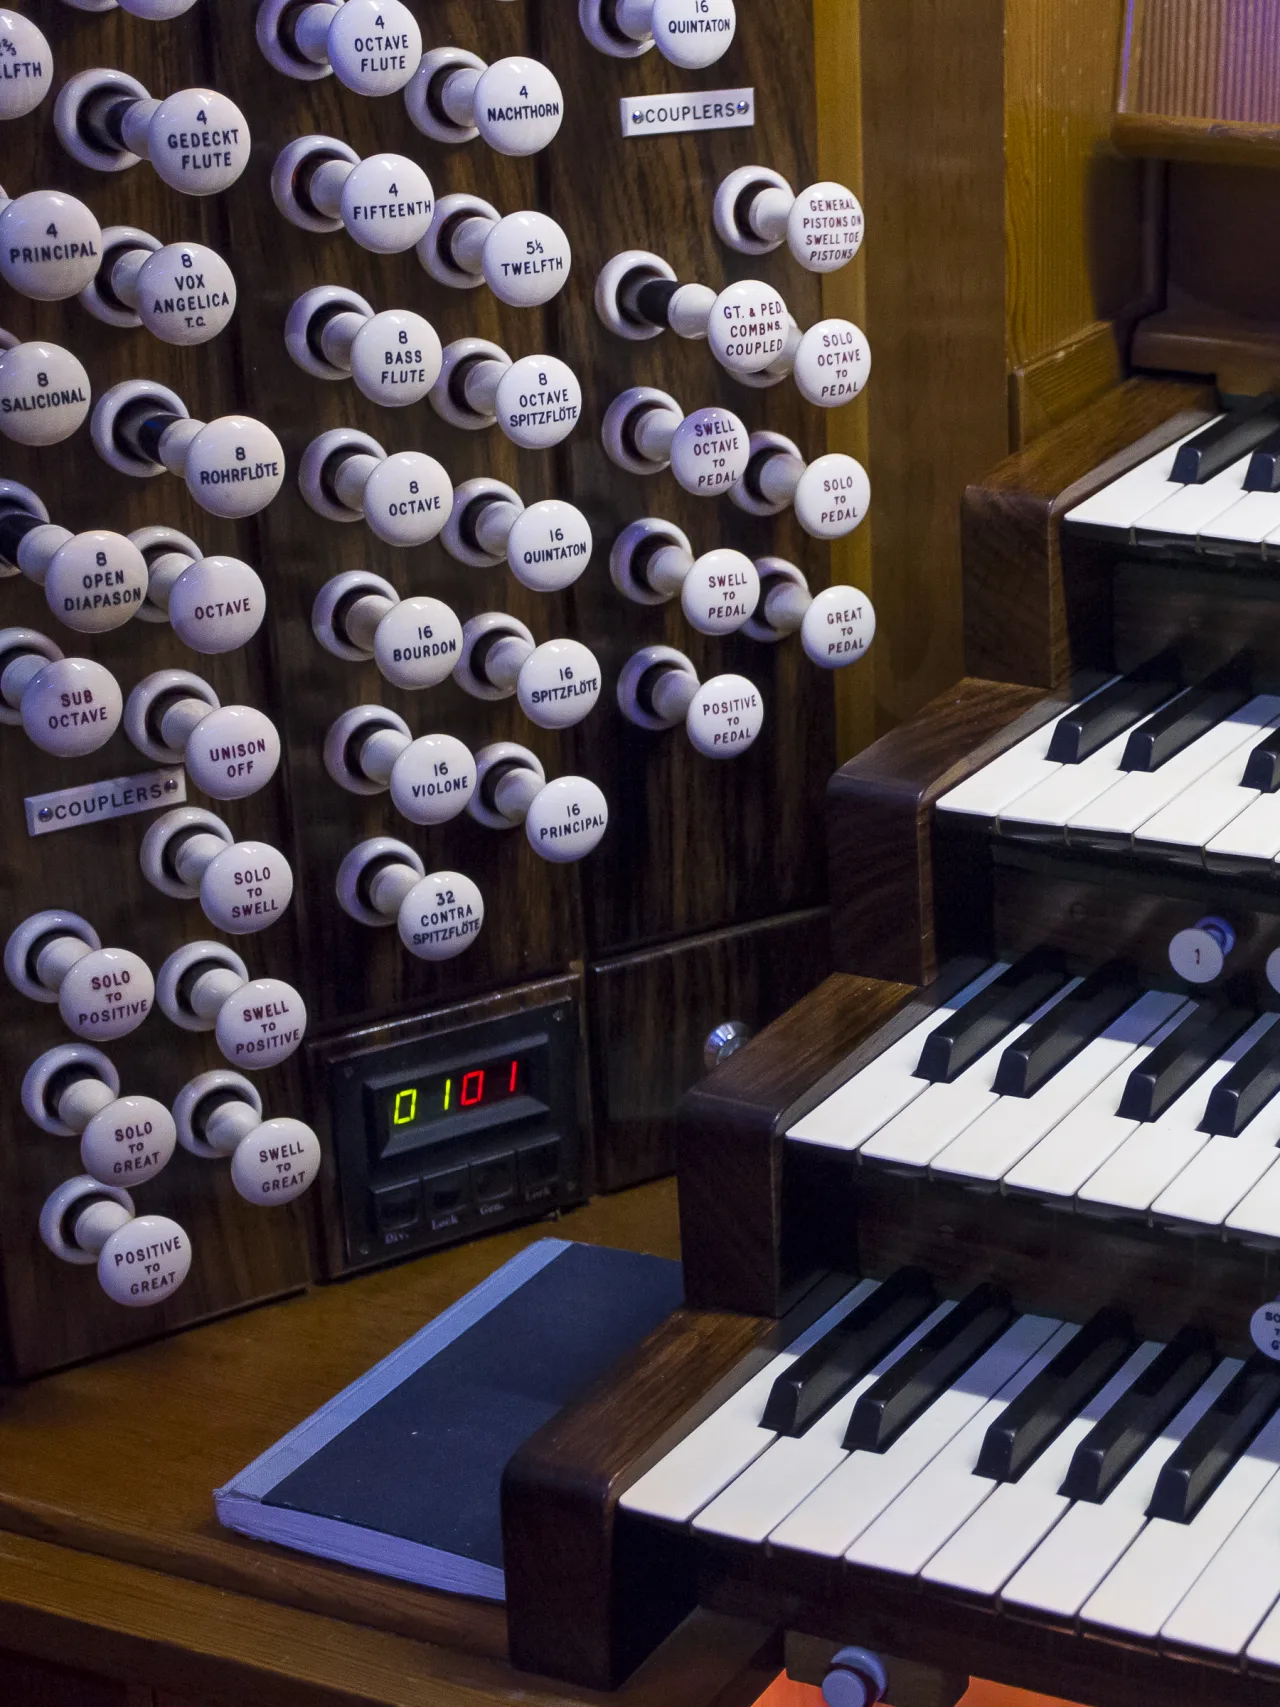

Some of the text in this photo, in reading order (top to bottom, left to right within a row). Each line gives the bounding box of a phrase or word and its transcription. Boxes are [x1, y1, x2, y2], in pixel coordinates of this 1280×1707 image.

[375, 15, 385, 29] 4
[668, 19, 730, 34] QUINTATON
[354, 35, 409, 53] OCTAVE
[361, 56, 406, 72] FLUTE
[519, 86, 528, 98] 4
[196, 110, 208, 124] 4
[487, 102, 559, 122] NACHTHORN
[645, 102, 735, 123] COUPLERS
[168, 129, 239, 149] GEDECKT
[182, 152, 232, 169] FLUTE
[388, 183, 398, 196] 4
[353, 201, 431, 220] FIFTEENTH
[809, 199, 855, 212] GENERAL
[46, 223, 58, 237] 4
[803, 216, 861, 229] PISTONS ON
[806, 232, 859, 245] SWELL TOE
[10, 242, 97, 263] PRINCIPAL
[181, 254, 192, 268] 8
[810, 249, 853, 261] PISTONS
[501, 257, 563, 276] TWELFTH
[174, 274, 205, 291] VOX
[153, 292, 230, 313] ANGELICA
[723, 301, 783, 319] GT. & PED.
[398, 331, 408, 344] 8
[822, 332, 853, 348] SOLO
[726, 338, 783, 357] COUPLED
[385, 350, 422, 365] BASS
[817, 349, 861, 366] OCTAVE
[37, 372, 49, 387] 8
[381, 369, 425, 384] FLUTE
[538, 373, 548, 385] 8
[836, 369, 848, 378] TO
[519, 389, 569, 407] OCTAVE
[821, 383, 859, 397] PEDAL
[1, 388, 86, 413] SALICIONAL
[509, 406, 578, 427] SPITZFLÖTE
[694, 420, 735, 437] SWELL
[235, 447, 246, 461] 8
[693, 438, 739, 456] OCTAVE
[713, 458, 725, 468] TO
[200, 463, 279, 485] ROHRFLÖTE
[698, 471, 737, 488] PEDAL
[409, 481, 419, 494] 8
[823, 477, 853, 492] SOLO
[389, 496, 441, 516] OCTAVE
[834, 495, 846, 505] TO
[821, 508, 858, 523] PEDAL
[550, 528, 564, 542] 16
[96, 552, 107, 566] 8
[523, 542, 587, 565] QUINTATON
[83, 570, 124, 589] OPEN
[708, 573, 748, 589] SWELL
[64, 587, 141, 611] DIAPASON
[723, 591, 736, 601] TO
[194, 598, 251, 620] OCTAVE
[708, 604, 747, 619] PEDAL
[827, 607, 863, 625] GREAT
[417, 626, 433, 640] 16
[841, 626, 854, 636] TO
[393, 639, 456, 662] BOURDON
[828, 638, 864, 655] PEDAL
[559, 666, 574, 680] 16
[61, 690, 93, 707] SUB
[531, 678, 598, 703] SPITZFLÖTE
[703, 695, 757, 716] POSITIVE
[48, 707, 108, 729] OCTAVE
[727, 716, 740, 727] TO
[713, 728, 751, 745] PEDAL
[210, 739, 266, 762] UNISON
[227, 761, 254, 778] OFF
[433, 762, 448, 777] 16
[412, 776, 468, 798] VIOLONE
[54, 784, 162, 820] COUPLERS
[566, 803, 581, 817] 16
[540, 814, 604, 840] PRINCIPAL
[234, 867, 271, 885] SOLO
[247, 887, 262, 897] TO
[436, 890, 456, 906] 32
[232, 899, 279, 918] SWELL
[420, 905, 473, 927] CONTRA
[412, 918, 480, 946] SPITZFLÖTE
[91, 970, 130, 990] SOLO
[106, 991, 122, 1002] TO
[79, 1000, 148, 1025] POSITIVE
[243, 1001, 289, 1022] SWELL
[261, 1022, 277, 1032] TO
[236, 1029, 300, 1055] POSITIVE
[115, 1122, 153, 1142] SOLO
[129, 1142, 144, 1153] TO
[259, 1141, 304, 1163] SWELL
[113, 1152, 160, 1174] GREAT
[276, 1163, 292, 1173] TO
[262, 1172, 306, 1193] GREAT
[432, 1215, 458, 1230] Lock
[115, 1236, 182, 1266] POSITIVE
[145, 1263, 160, 1274] TO
[131, 1272, 176, 1294] GREAT
